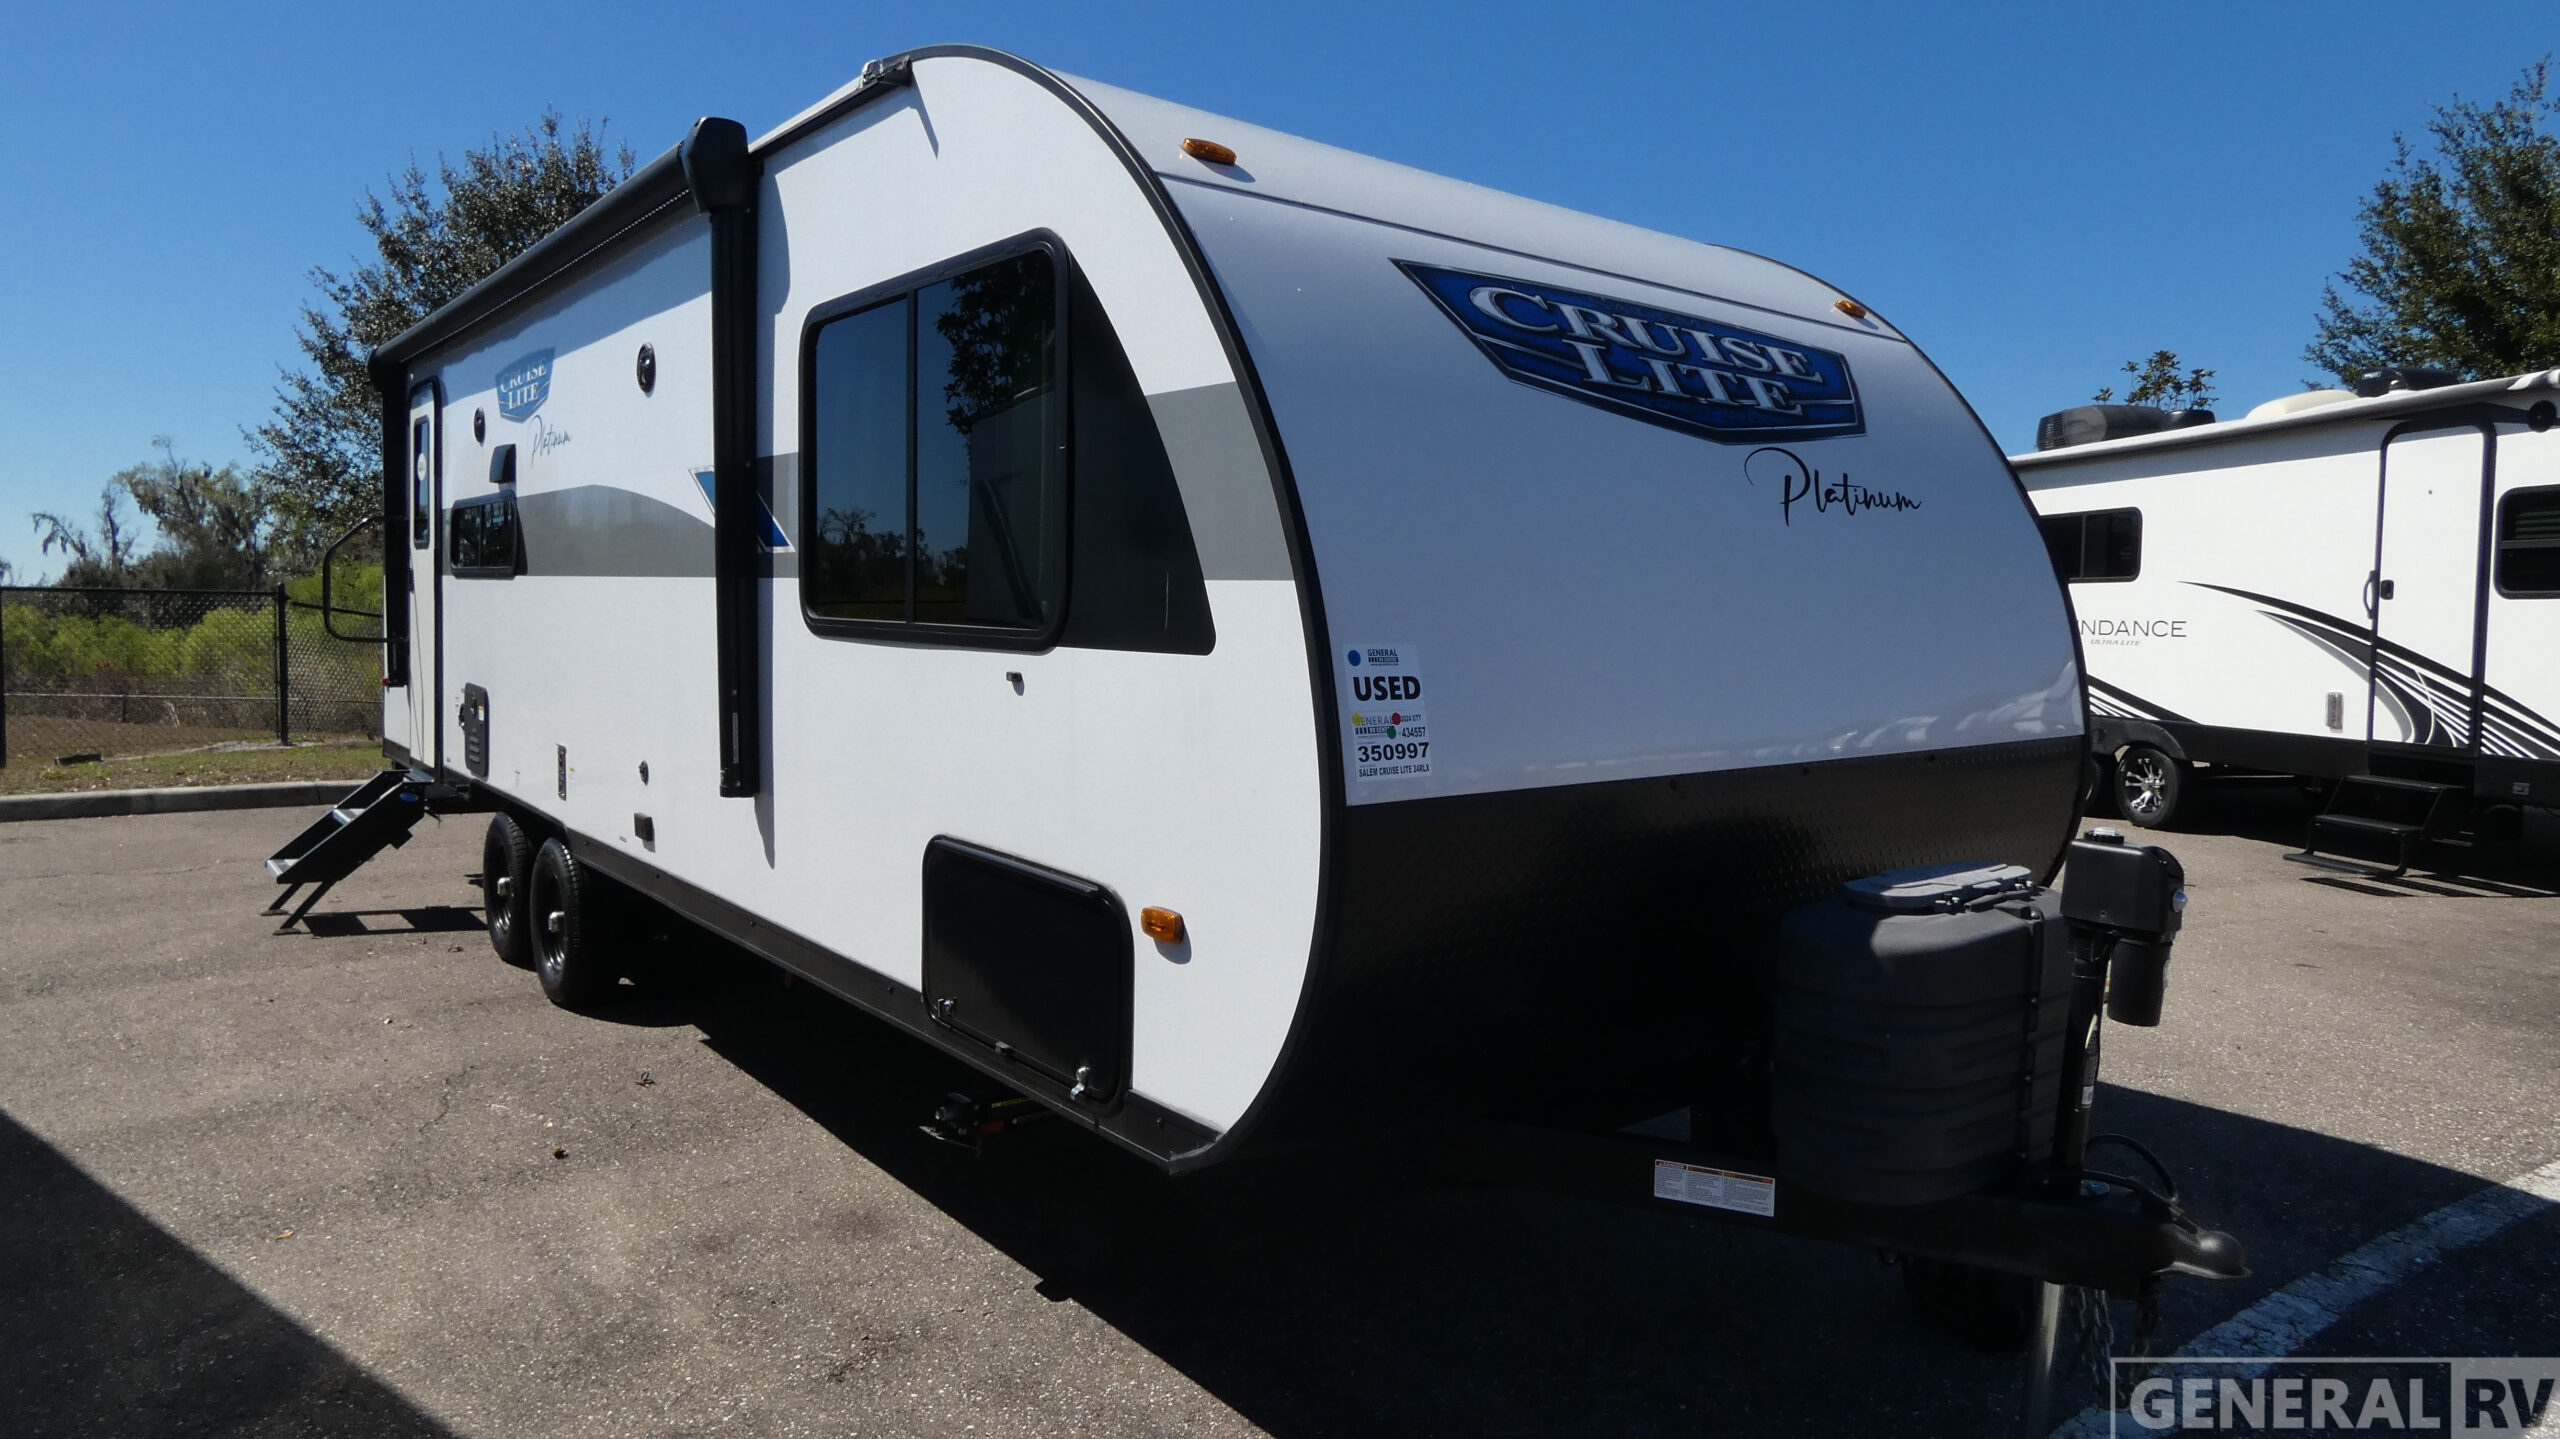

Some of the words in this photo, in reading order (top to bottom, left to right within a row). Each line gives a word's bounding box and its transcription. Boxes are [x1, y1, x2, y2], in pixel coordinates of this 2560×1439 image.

[1468, 286, 1823, 384] CRUISE
[500, 361, 547, 393] CRUISE
[1563, 340, 1805, 415] LITE
[507, 382, 539, 410] LITE
[527, 414, 573, 469] Platinum
[1744, 447, 1922, 526] Platinum
[2079, 619, 2187, 637] NDANCE
[1367, 648, 1398, 657] GENERAL
[1353, 675, 1421, 701] USED
[1358, 742, 1429, 763] 350997
[1359, 767, 1378, 777] SALEM
[1379, 766, 1399, 776] CRUISE
[1400, 764, 1412, 774] LITE
